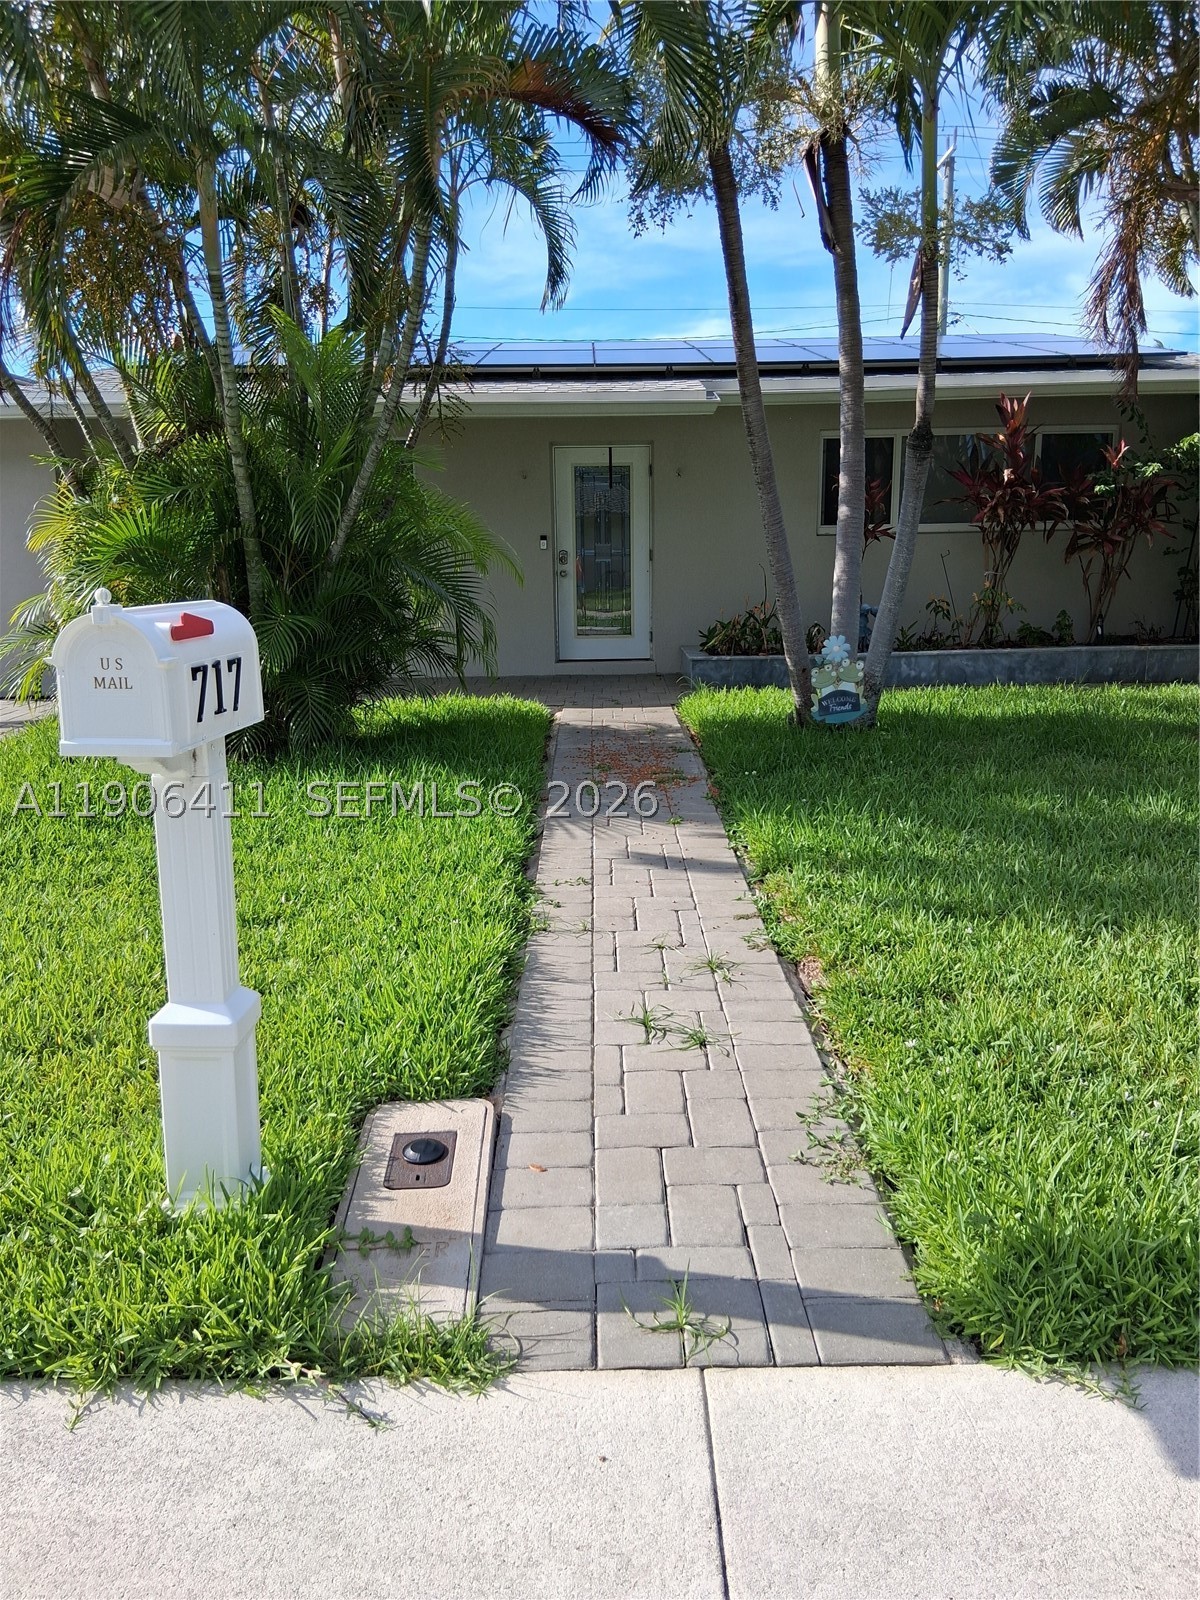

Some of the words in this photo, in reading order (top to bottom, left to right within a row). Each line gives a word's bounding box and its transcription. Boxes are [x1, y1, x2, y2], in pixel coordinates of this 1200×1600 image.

[93, 676, 133, 690] MAIL
[191, 656, 242, 723] 717
[821, 696, 857, 707] WELCOME
[829, 702, 853, 712] Friends
